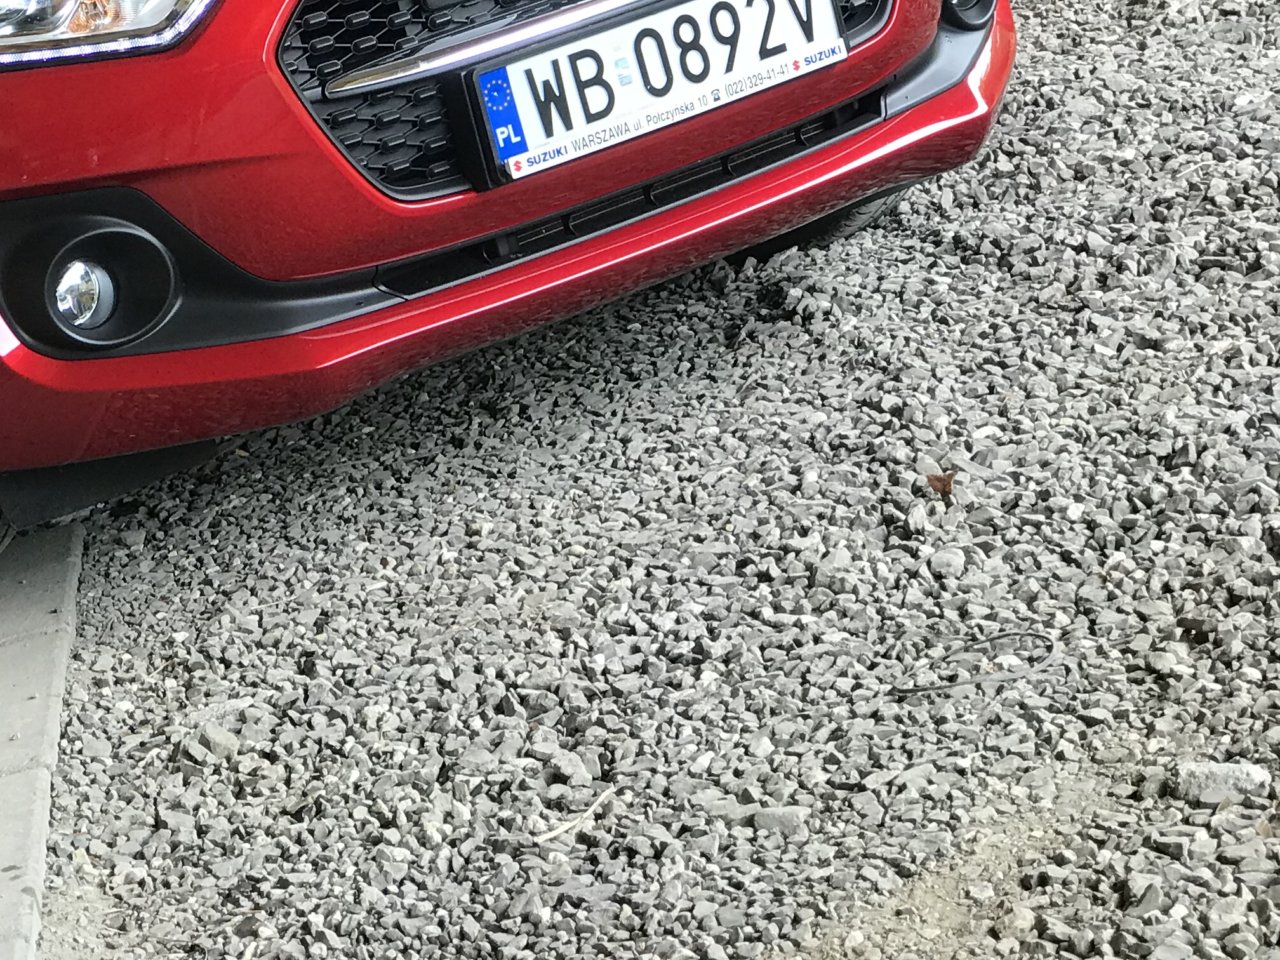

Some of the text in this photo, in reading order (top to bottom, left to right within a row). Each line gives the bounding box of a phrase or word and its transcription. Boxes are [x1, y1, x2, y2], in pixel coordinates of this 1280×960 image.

[496, 124, 521, 147] PL
[524, 49, 616, 139] WB
[526, 145, 569, 167] SUZUKI
[571, 122, 631, 153] WARSZAWA
[633, 118, 645, 131] ul.
[698, 95, 708, 107] 10
[804, 45, 842, 67] SUZUKI
